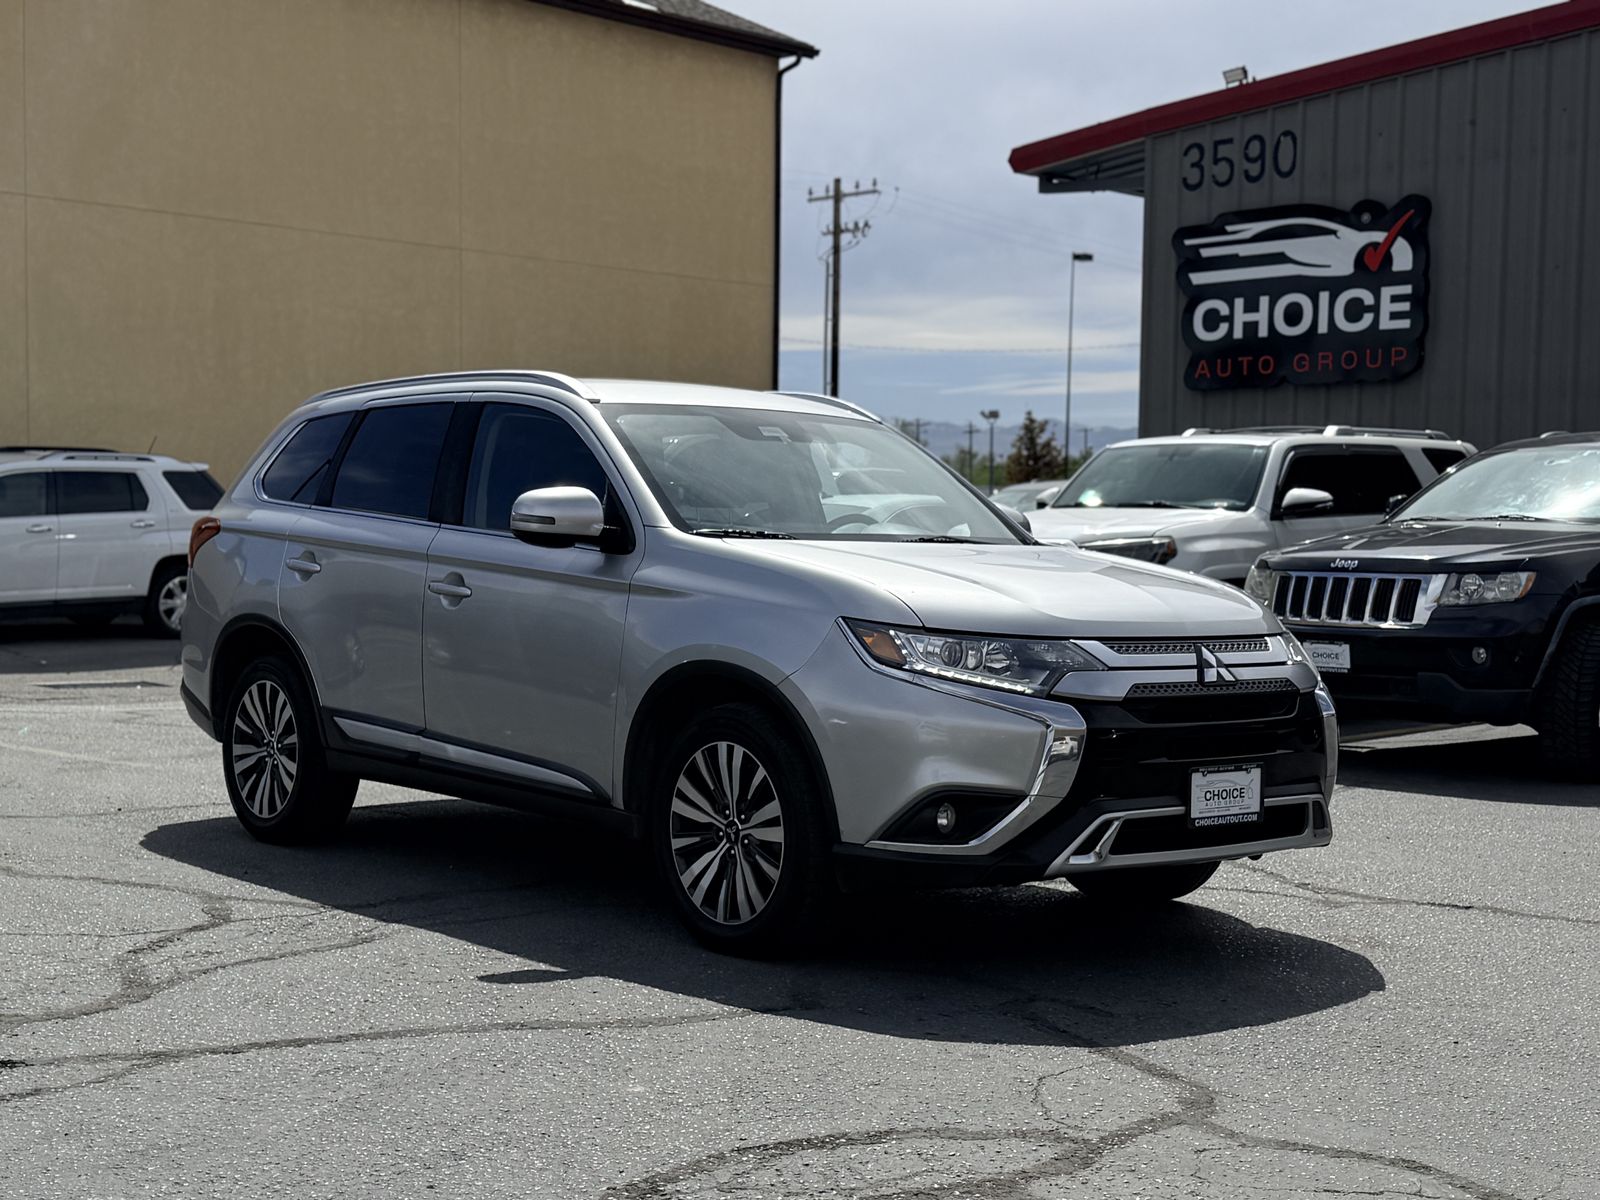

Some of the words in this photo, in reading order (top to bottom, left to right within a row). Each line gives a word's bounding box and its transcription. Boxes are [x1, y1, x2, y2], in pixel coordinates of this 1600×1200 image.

[1182, 130, 1297, 191] 3590
[1192, 284, 1413, 342] CHOICE
[1194, 355, 1275, 379] AUTO
[1293, 347, 1408, 373] GROUP
[1330, 558, 1359, 570] Jeep
[1312, 651, 1340, 660] CHOICE
[1204, 787, 1246, 801] CHOICE
[1195, 813, 1258, 827] CHOICEAUTOUT.COM
